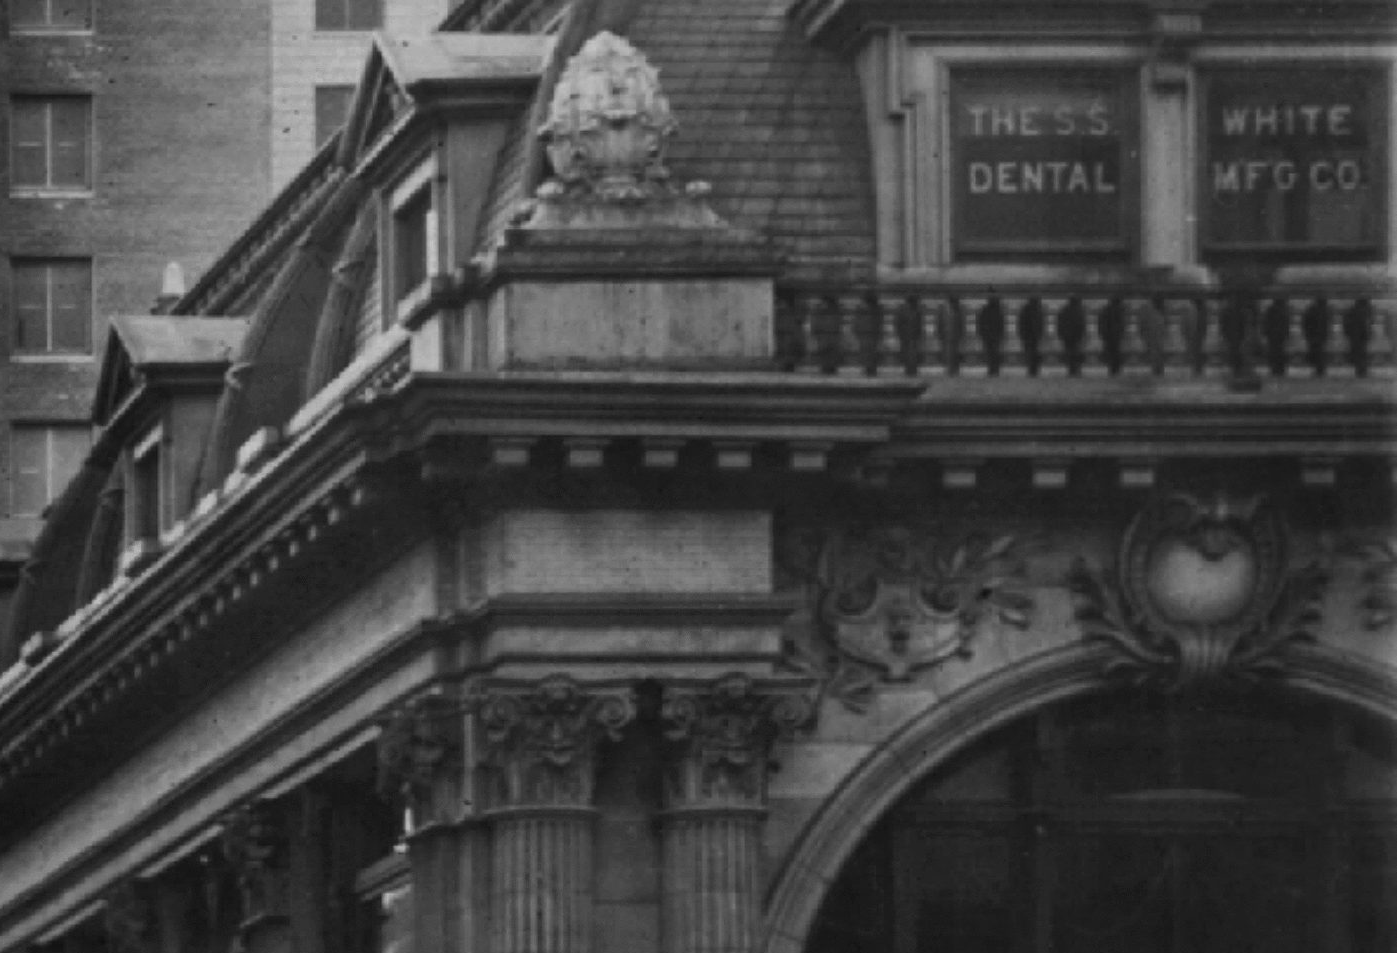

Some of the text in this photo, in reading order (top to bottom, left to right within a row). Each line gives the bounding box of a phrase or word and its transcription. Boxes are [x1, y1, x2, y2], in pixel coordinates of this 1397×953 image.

[968, 104, 1041, 136] THE
[1222, 104, 1353, 136] WHITE
[968, 161, 1116, 194] DENTAL
